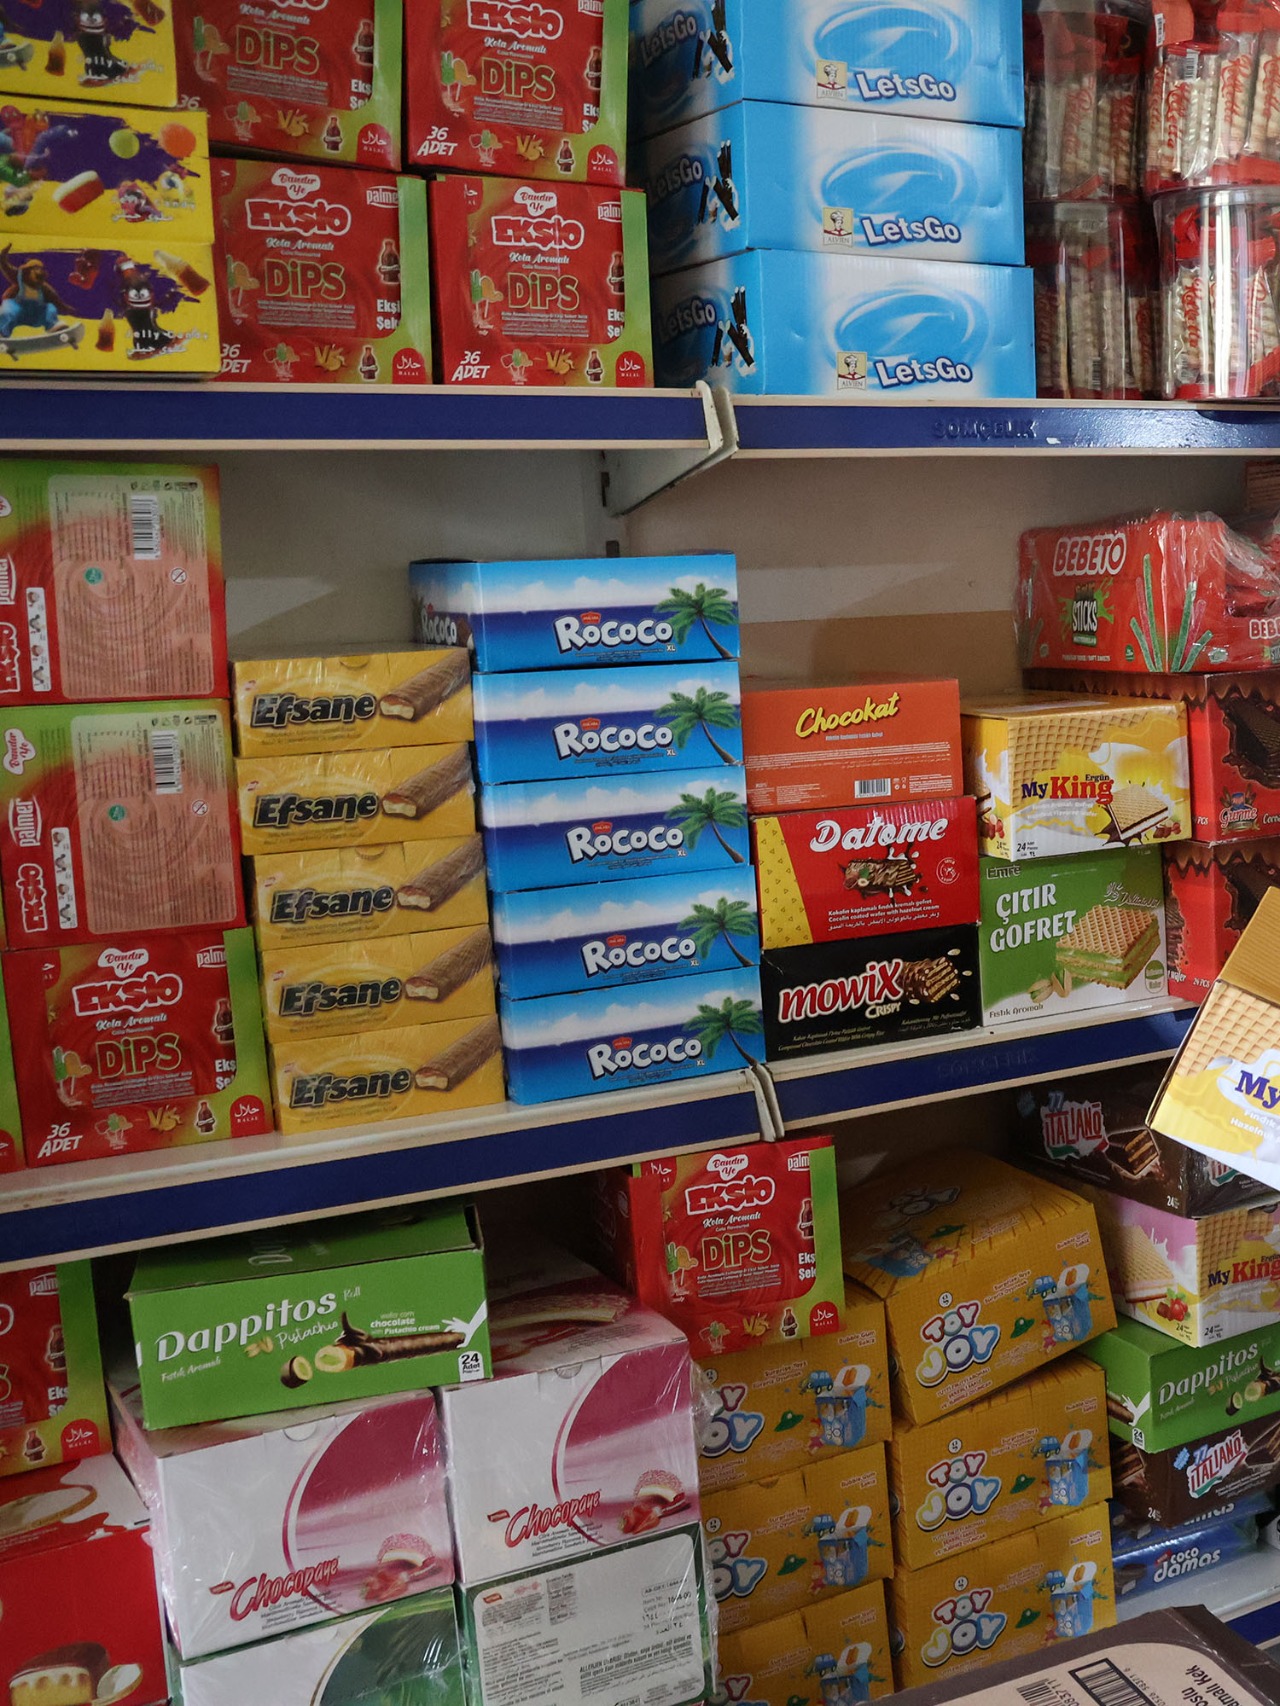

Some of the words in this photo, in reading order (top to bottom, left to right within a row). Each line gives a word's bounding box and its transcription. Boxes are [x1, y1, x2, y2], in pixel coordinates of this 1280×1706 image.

[417, 141, 457, 156] ADET
[429, 126, 448, 140] 36
[509, 251, 531, 263] Kola
[221, 344, 240, 358] 36
[221, 359, 251, 374] DET
[460, 351, 481, 365] 36
[451, 365, 490, 381] ADET
[1053, 532, 1127, 577] BEBETO
[1072, 599, 1098, 633] STICKS
[251, 692, 377, 729] Efsane
[795, 692, 900, 739] Chocokat
[1021, 779, 1048, 800] My
[1050, 775, 1114, 805] King
[1085, 773, 1110, 783] Ergün
[17, 797, 40, 847] palmer
[253, 792, 380, 829] Efsane
[810, 817, 948, 852] Datome
[1017, 842, 1026, 852] 24
[270, 886, 396, 923] Efsane
[996, 883, 1057, 924] ÇITIR
[990, 909, 1077, 953] GOFRET
[279, 977, 403, 1017] Efsane
[96, 1019, 121, 1031] Kola
[290, 1068, 413, 1109] Efsane
[47, 1122, 71, 1139] 36
[38, 1135, 83, 1159] ADET
[1167, 1196, 1175, 1207] 24
[703, 1217, 724, 1229] Kola
[1208, 1269, 1230, 1287] My
[157, 1291, 337, 1362] Dappitos
[370, 1317, 415, 1328] chocolate
[385, 1326, 417, 1334] Pistachio
[920, 1300, 981, 1343] TOY
[1176, 1323, 1183, 1332] 24
[1205, 1327, 1214, 1336] 24
[461, 1353, 479, 1365] 24
[915, 1324, 1000, 1387] JOY
[1159, 1343, 1258, 1406] Dappitos
[700, 1412, 765, 1458] OY
[1133, 1429, 1143, 1437] 24
[926, 1451, 987, 1488] TOY
[505, 1489, 601, 1548] Chocopaye
[916, 1477, 1000, 1532] JOY
[1148, 1507, 1156, 1518] 24
[1153, 1550, 1221, 1583] damas
[229, 1556, 340, 1621] Chocopaye
[932, 1588, 993, 1625] TOY
[921, 1612, 1006, 1668] JOY
[1186, 1664, 1212, 1685] Kek
